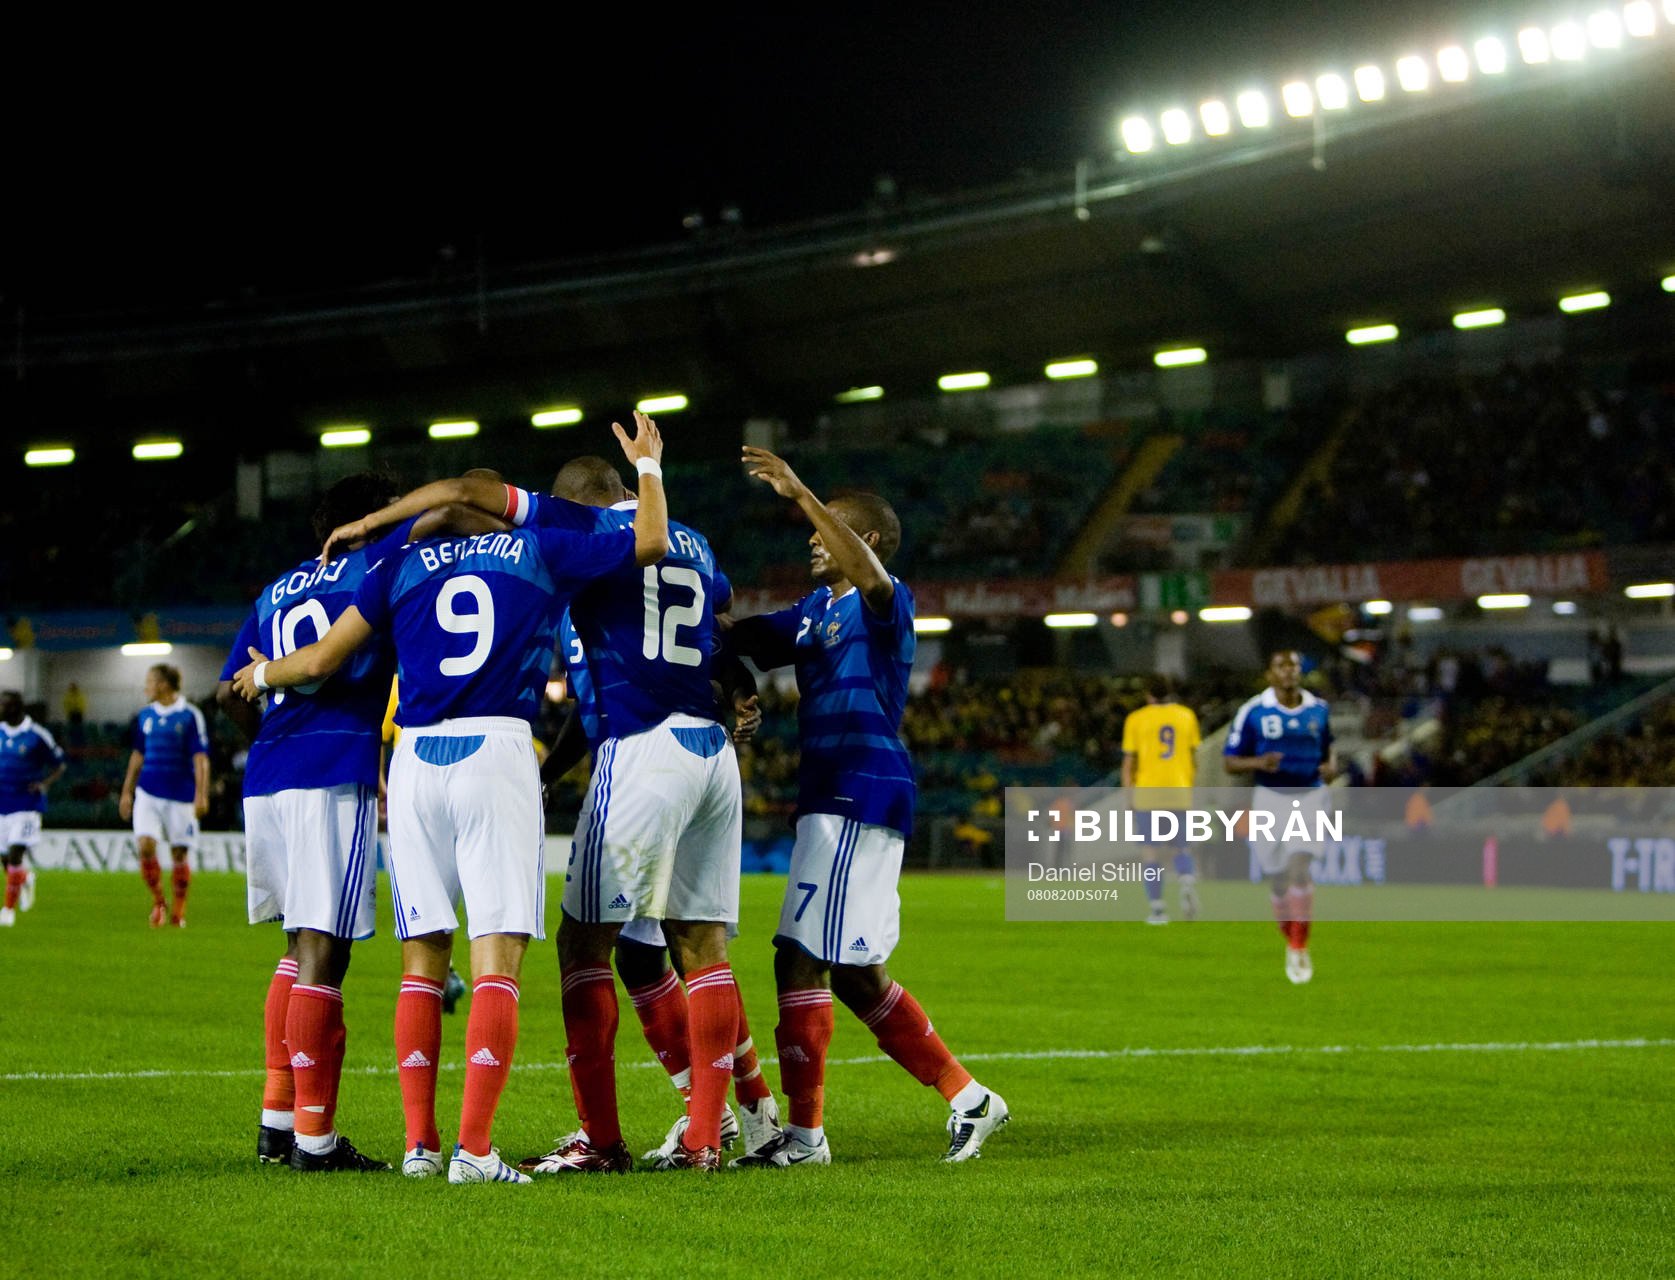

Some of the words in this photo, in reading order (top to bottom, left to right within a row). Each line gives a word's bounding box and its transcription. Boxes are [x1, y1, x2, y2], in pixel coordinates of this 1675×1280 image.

[271, 598, 331, 705] 10
[435, 574, 495, 677] 9
[643, 564, 706, 668] 12
[1159, 725, 1175, 759] 9
[794, 881, 818, 922] 7
